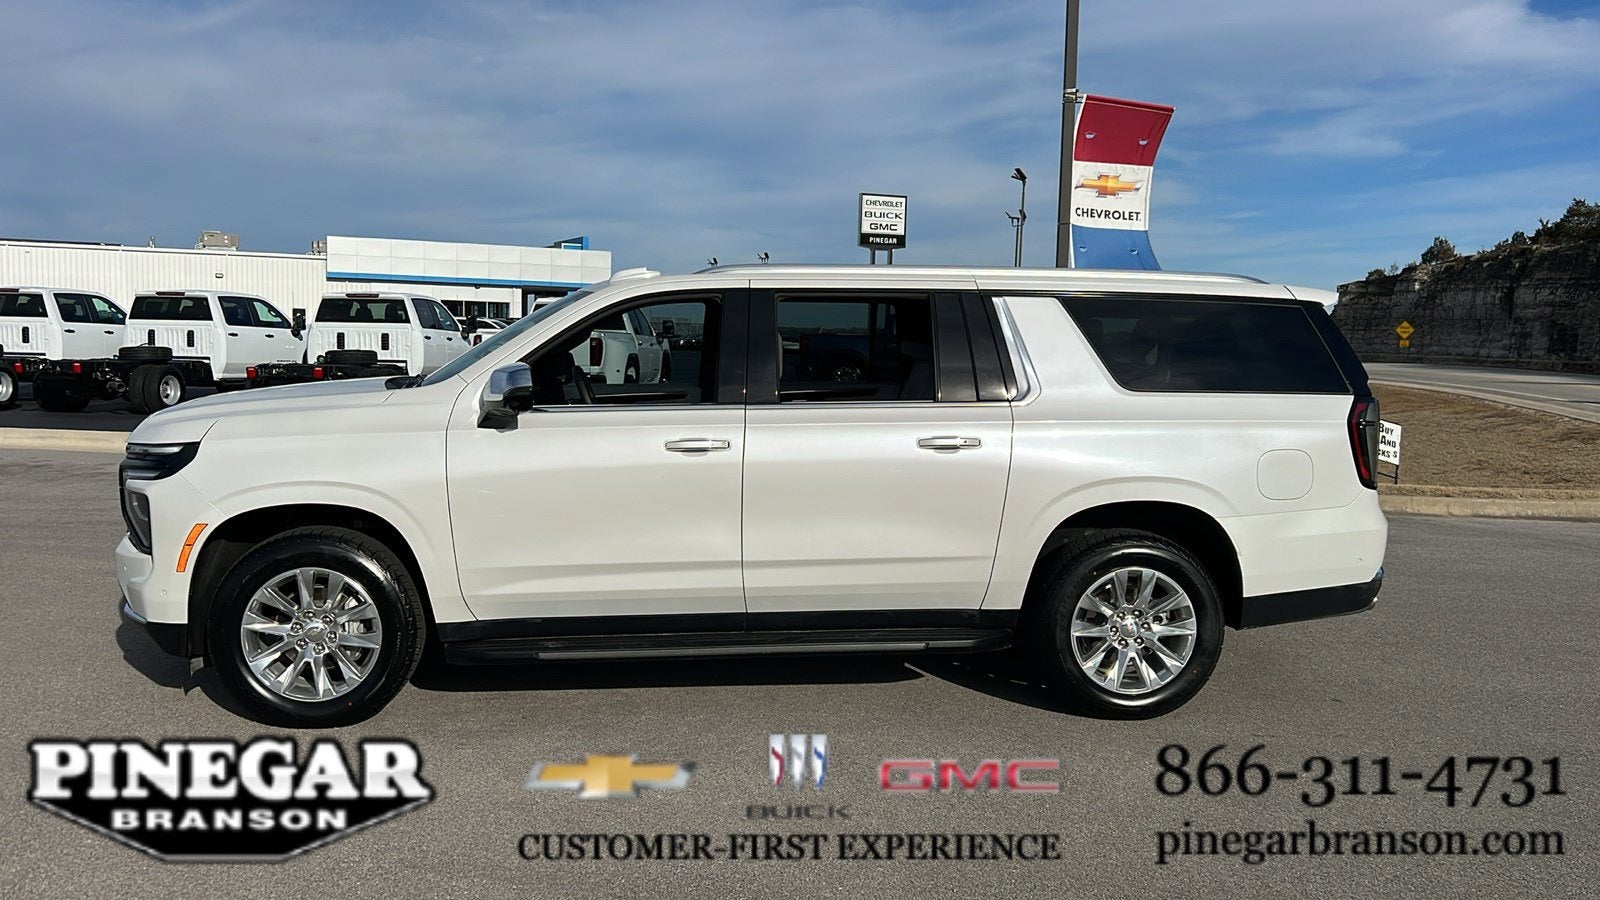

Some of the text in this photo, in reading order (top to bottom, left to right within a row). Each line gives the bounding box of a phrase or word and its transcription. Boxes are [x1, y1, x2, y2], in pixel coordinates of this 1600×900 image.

[865, 199, 904, 208] CHEVROLET
[864, 211, 903, 220] BUICK
[1075, 206, 1141, 222] CHEVROLET
[869, 222, 898, 231] GMC
[869, 236, 898, 245] PINEGAR
